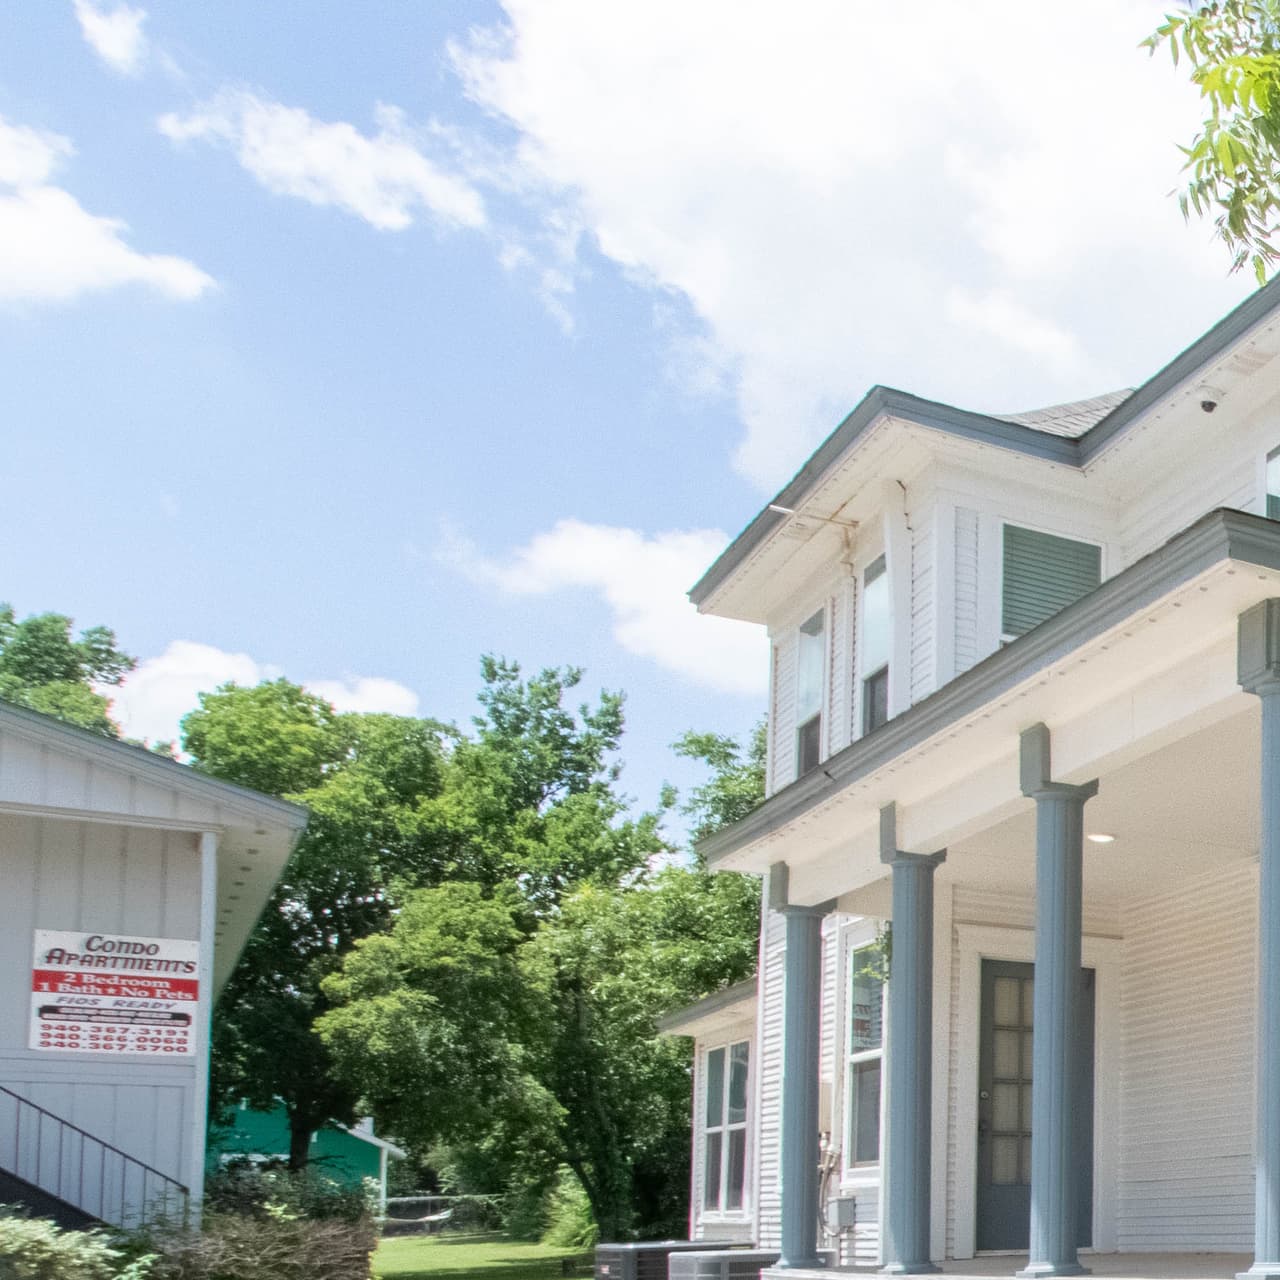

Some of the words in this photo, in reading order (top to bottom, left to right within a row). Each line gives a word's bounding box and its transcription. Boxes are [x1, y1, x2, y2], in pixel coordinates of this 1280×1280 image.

[64, 973, 76, 983] 2
[82, 974, 170, 988] Bedroom
[40, 983, 50, 992] 1
[58, 983, 104, 995] Bath
[120, 986, 149, 998] No
[154, 988, 194, 1000] Pets
[112, 999, 177, 1010] READY
[40, 1024, 189, 1036] 940.367.3191
[39, 1041, 188, 1053] 940.367.5700
